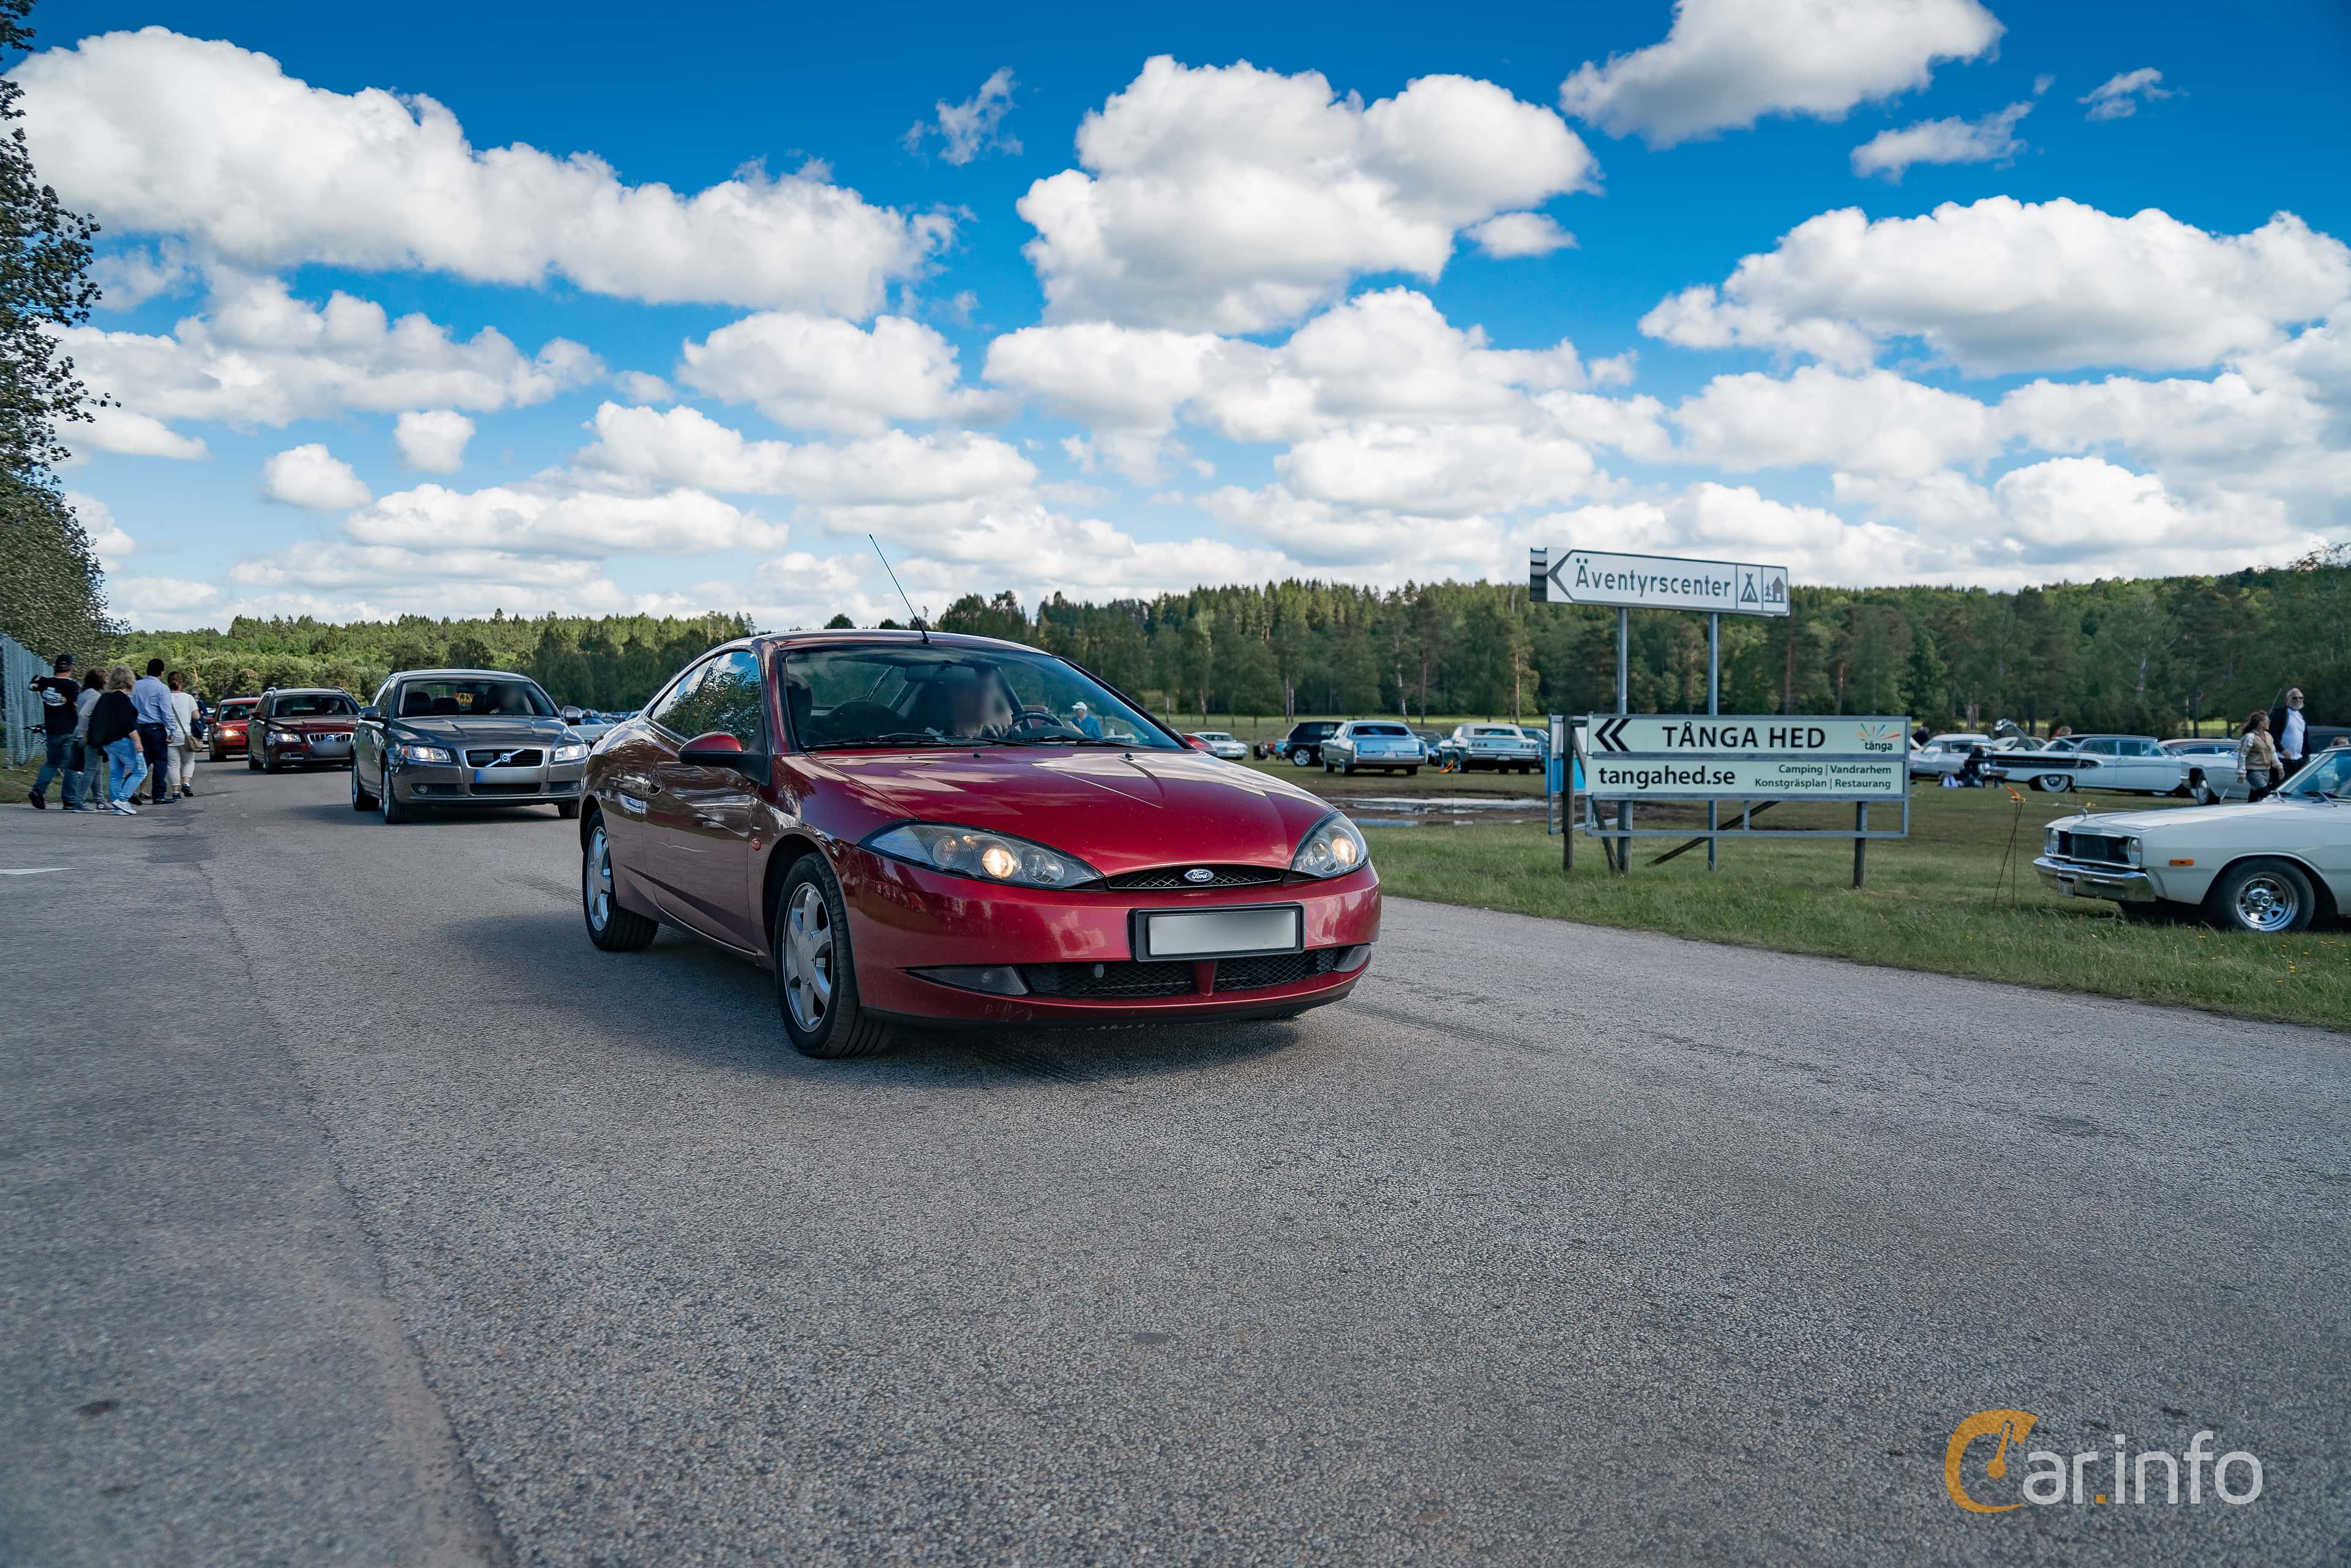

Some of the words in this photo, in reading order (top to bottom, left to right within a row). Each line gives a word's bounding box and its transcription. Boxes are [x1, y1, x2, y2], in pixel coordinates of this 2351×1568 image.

[1575, 557, 1731, 598] Äventyrscenter
[1662, 721, 1759, 748] TÅNGA
[1769, 727, 1826, 748] HED
[1865, 740, 1893, 752] tånga
[1599, 765, 1736, 790] tangahed.se
[1779, 764, 1823, 776] Camping
[1831, 765, 1892, 775] Vandrarhem
[1755, 778, 1828, 789] Konstgräsplan
[1835, 779, 1892, 790] Restaurang
